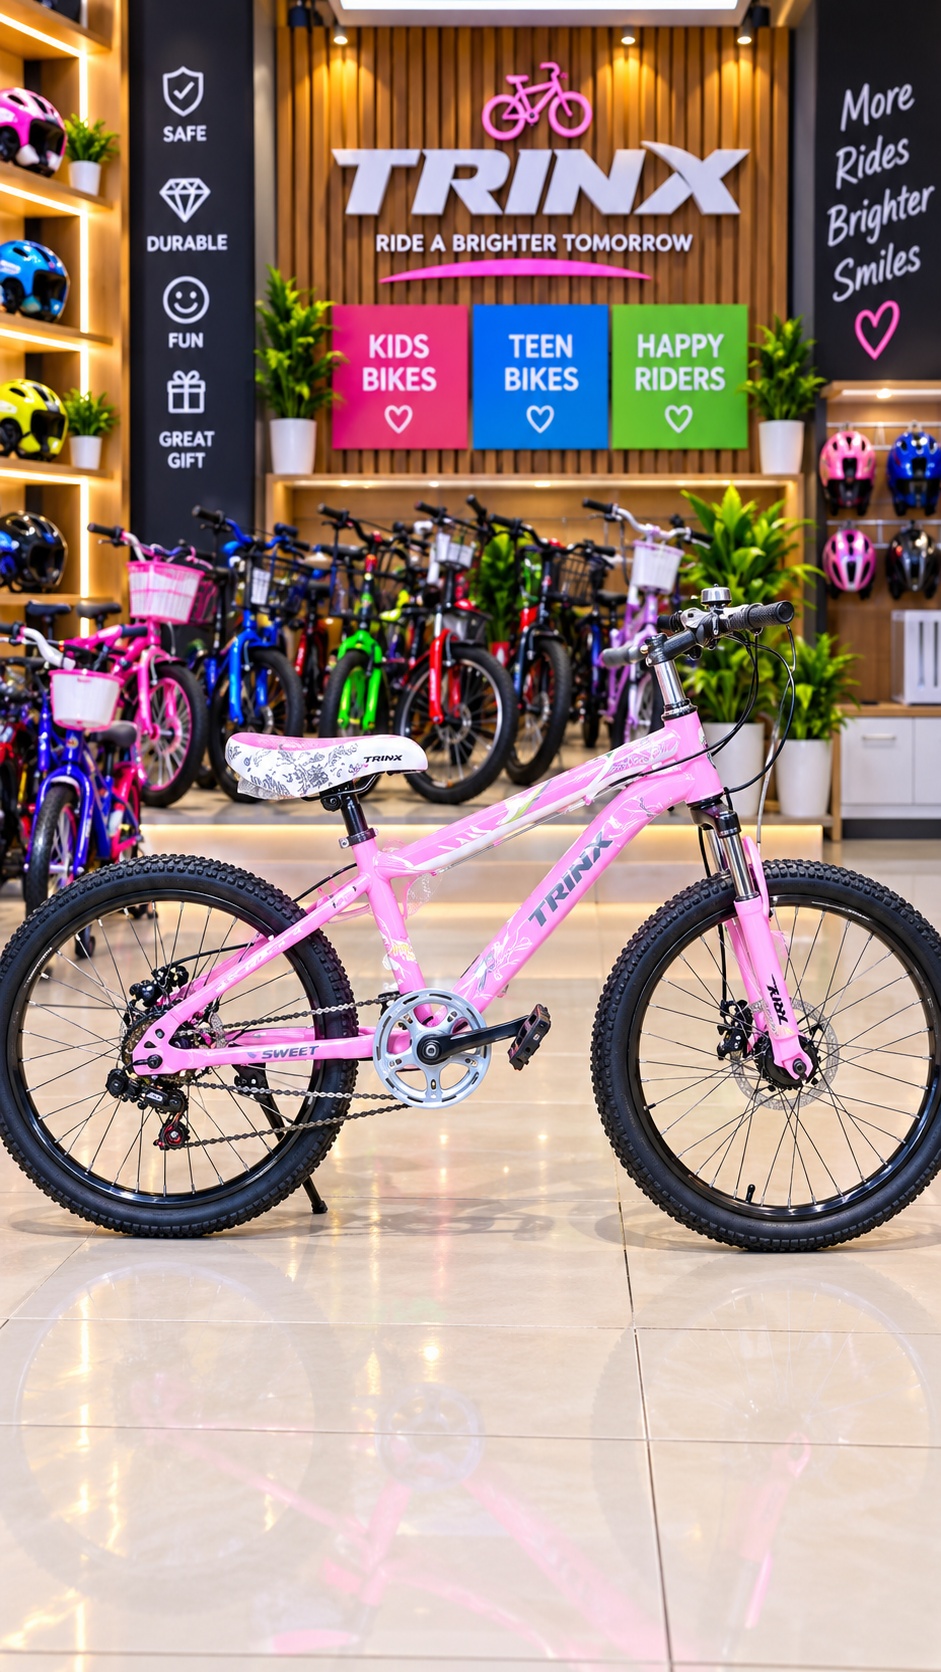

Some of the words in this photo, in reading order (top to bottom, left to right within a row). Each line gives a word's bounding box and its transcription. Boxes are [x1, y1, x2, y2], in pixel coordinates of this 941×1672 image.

[840, 83, 915, 131] More
[163, 125, 207, 143] SAFE
[836, 136, 909, 190] Rides
[332, 141, 750, 215] TRINX
[827, 183, 935, 247] Brighter
[147, 234, 228, 252] DURABLE
[376, 233, 424, 252] RIDE
[431, 234, 446, 252] A
[452, 233, 556, 252] BRIGHTER
[563, 233, 693, 252] TOMORROW
[832, 245, 921, 303] Smiles
[168, 332, 204, 348] FUN
[369, 334, 430, 359] KIDS
[509, 334, 573, 358] TEEN
[637, 334, 724, 359] HAPPY
[363, 367, 437, 391] BIKES
[505, 367, 579, 391] BIKES
[635, 367, 725, 391] RIDERS
[159, 431, 215, 447] GREAT
[167, 453, 206, 469] GIFT
[363, 754, 403, 763] TRINX
[528, 831, 613, 927] TRINX
[261, 1045, 319, 1059] SWEET
